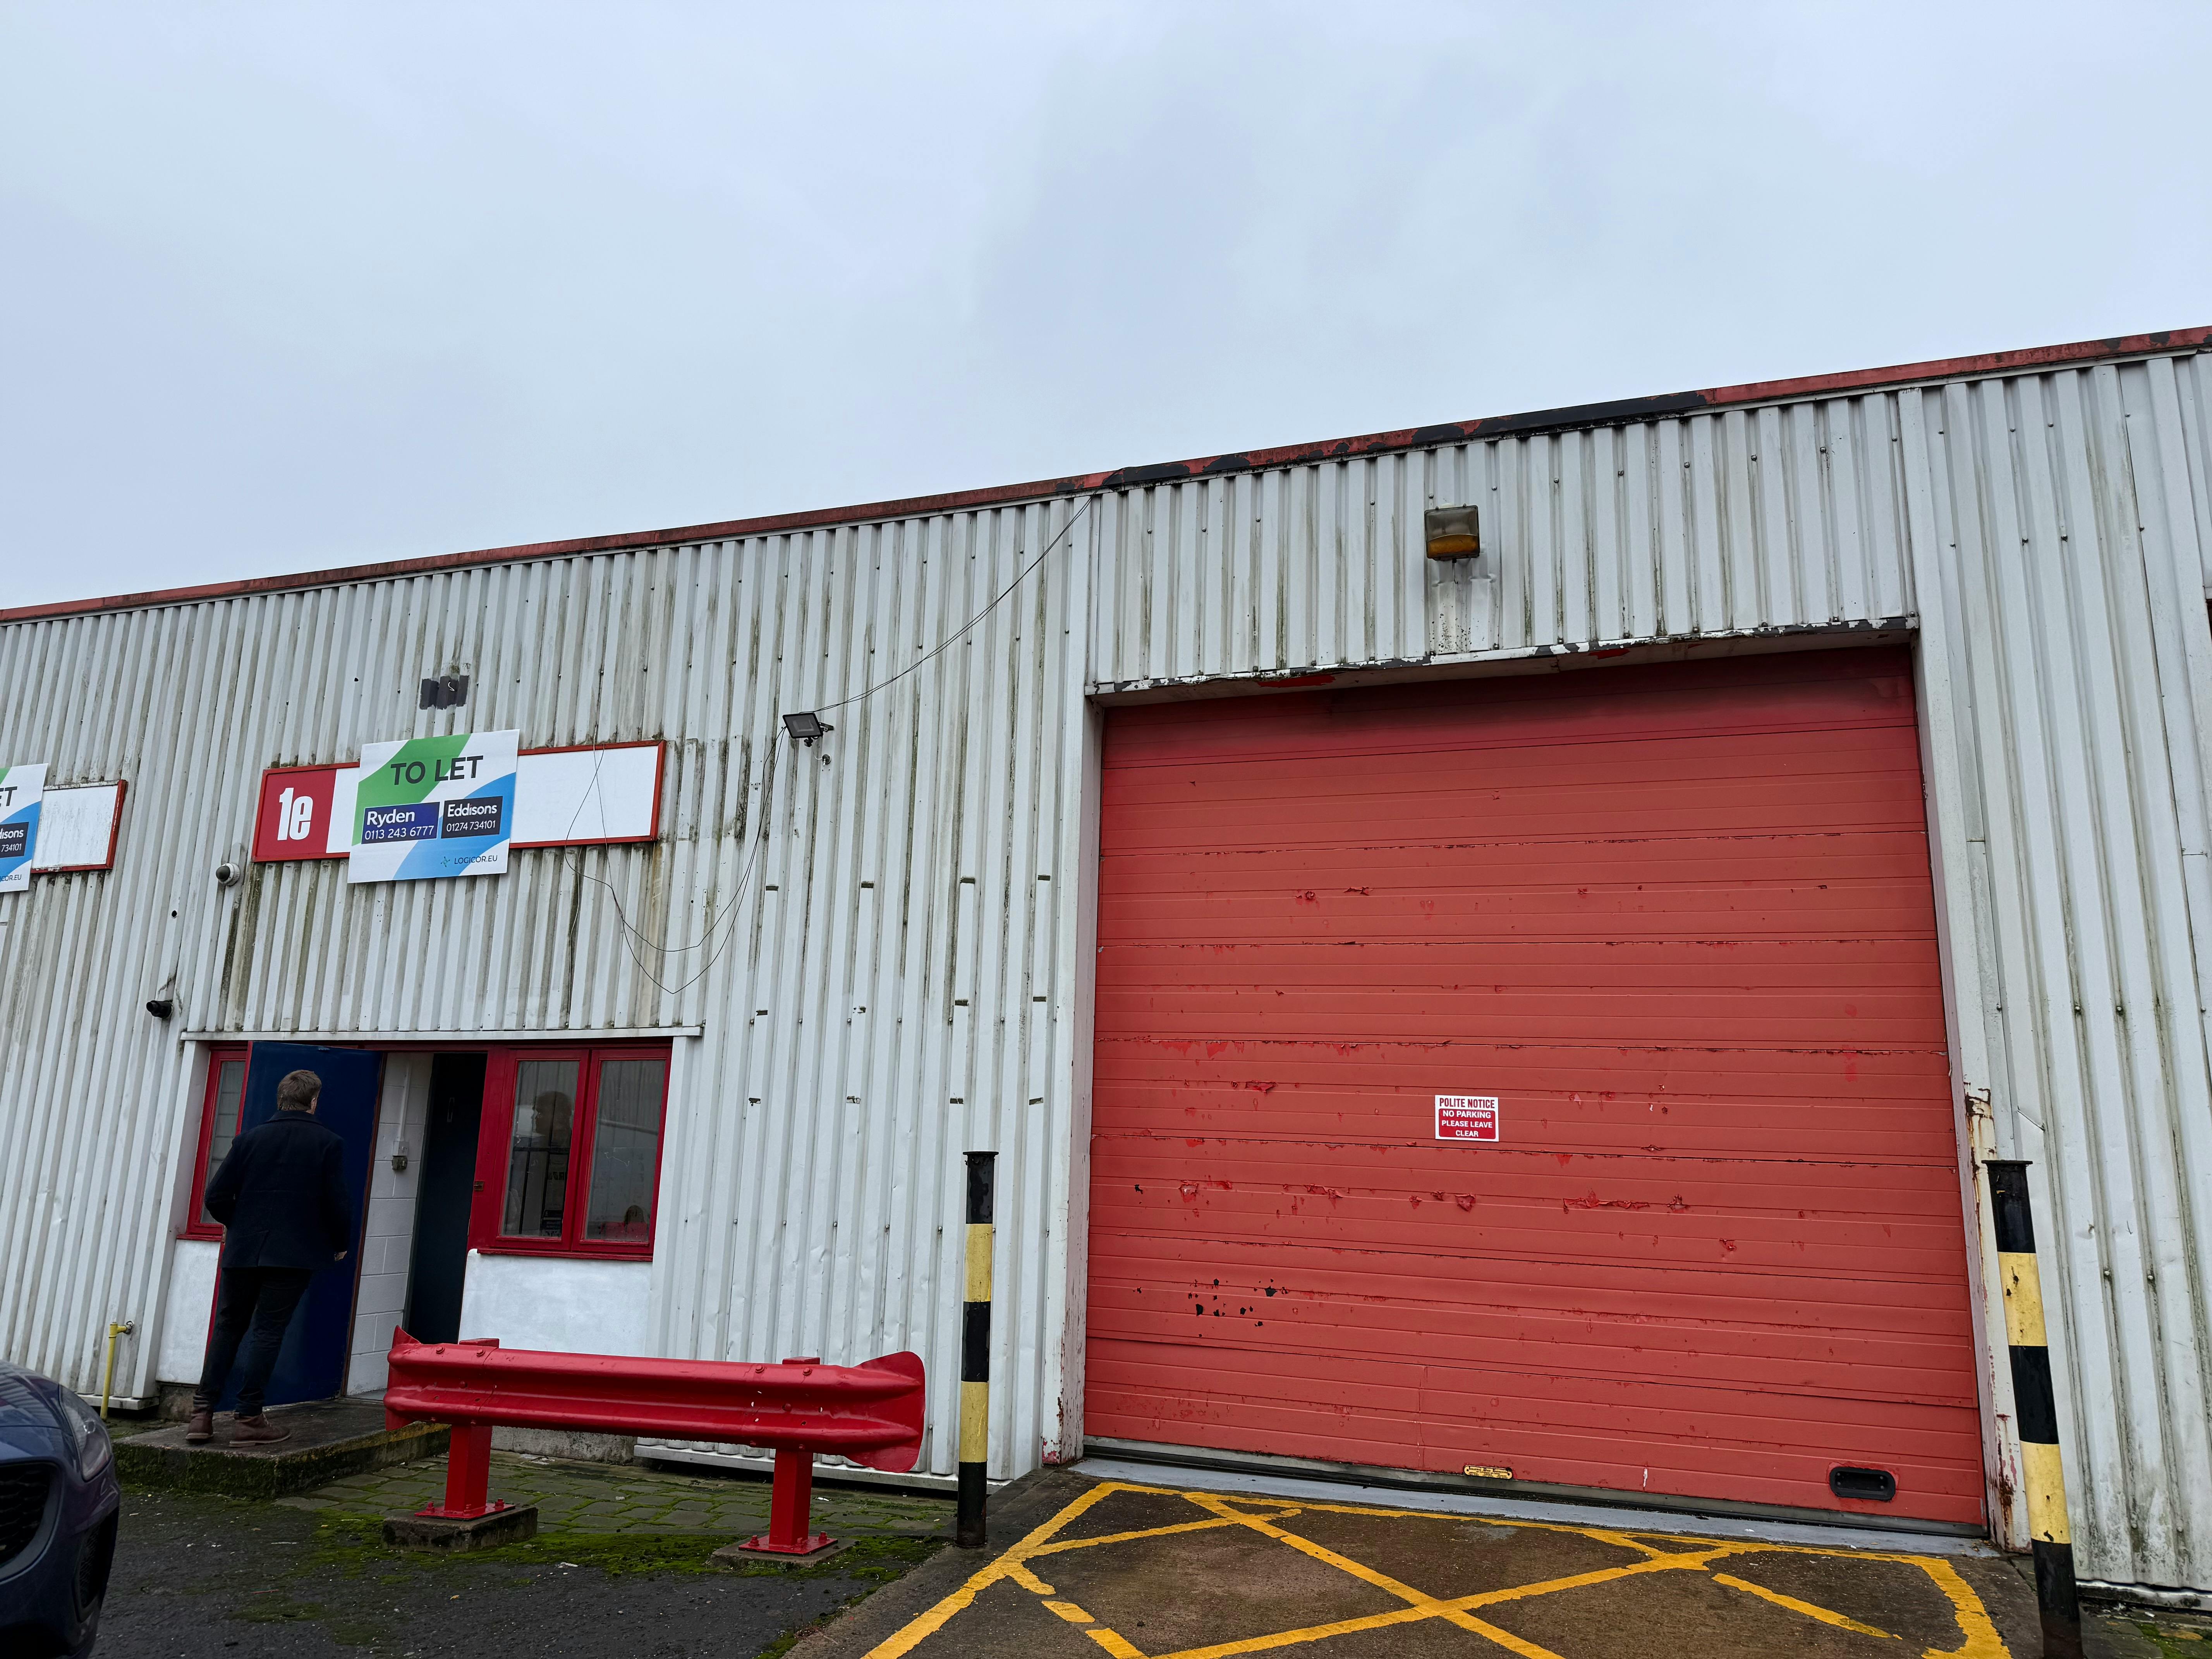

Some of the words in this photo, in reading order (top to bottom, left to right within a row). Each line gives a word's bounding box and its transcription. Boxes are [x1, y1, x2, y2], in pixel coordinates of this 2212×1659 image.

[390, 761, 426, 785] TO
[434, 755, 483, 781] LET
[0, 786, 18, 807] T
[277, 787, 313, 841] 1e
[447, 803, 497, 817] Eddisons
[367, 809, 415, 828] Ryden
[365, 829, 385, 840] 0113
[388, 828, 407, 838] 243
[410, 825, 434, 836] 6777
[447, 822, 468, 832] 01274
[470, 820, 496, 830] 734101
[1, 843, 22, 852] 734101
[454, 855, 498, 864] LOGICOR.EU
[1439, 1097, 1465, 1108] POLITE
[1468, 1099, 1495, 1109] NOTICE
